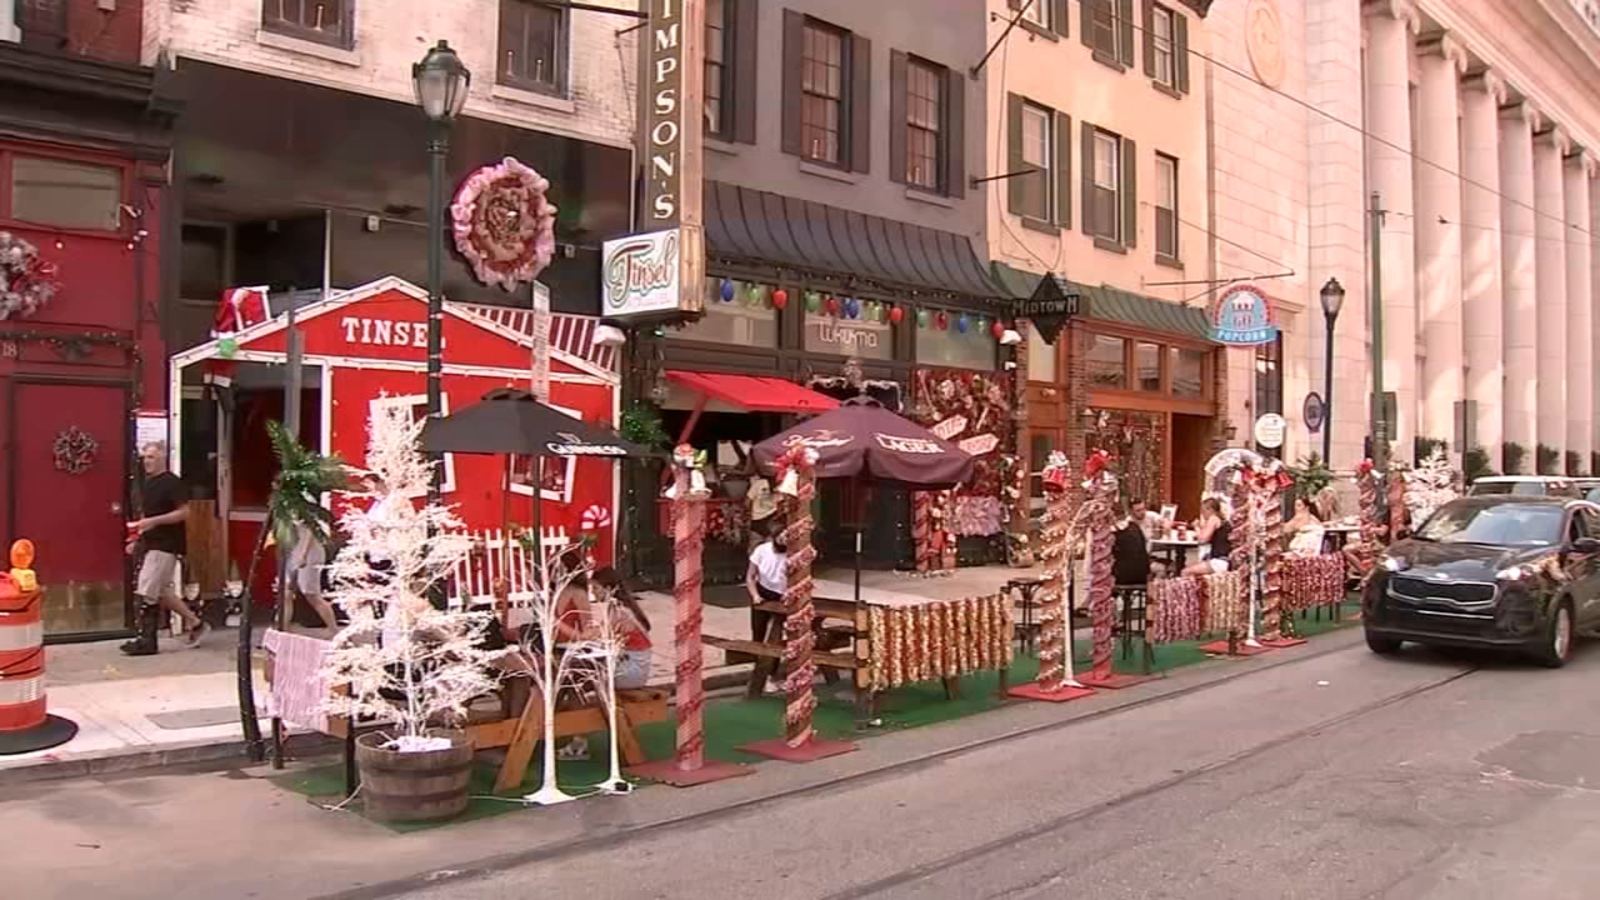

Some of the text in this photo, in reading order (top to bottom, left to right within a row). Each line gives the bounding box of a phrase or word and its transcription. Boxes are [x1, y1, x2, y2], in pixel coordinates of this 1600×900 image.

[604, 231, 677, 308] Tinsel
[341, 316, 446, 349] TINSE
[1217, 329, 1267, 342] POPCORN
[876, 434, 946, 453] LAGER
